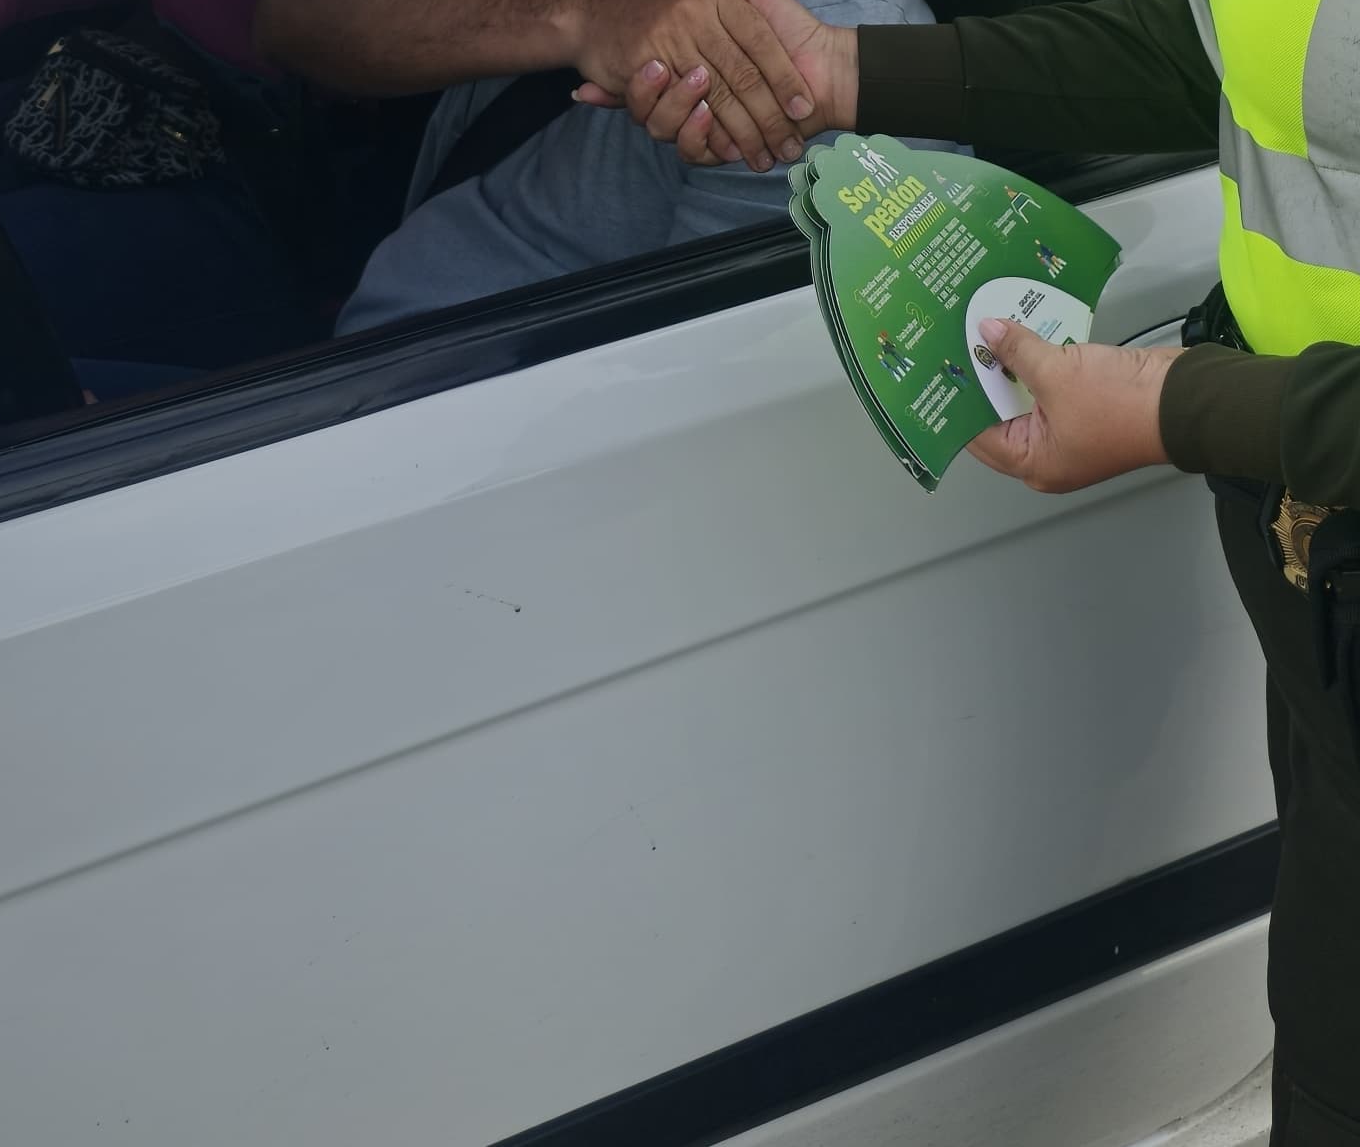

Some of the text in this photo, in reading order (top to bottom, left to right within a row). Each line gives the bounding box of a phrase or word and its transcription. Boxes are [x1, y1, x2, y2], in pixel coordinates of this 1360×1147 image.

[838, 176, 883, 214] Soy
[864, 174, 927, 250] peatón
[889, 191, 939, 242] RESPONSABLE
